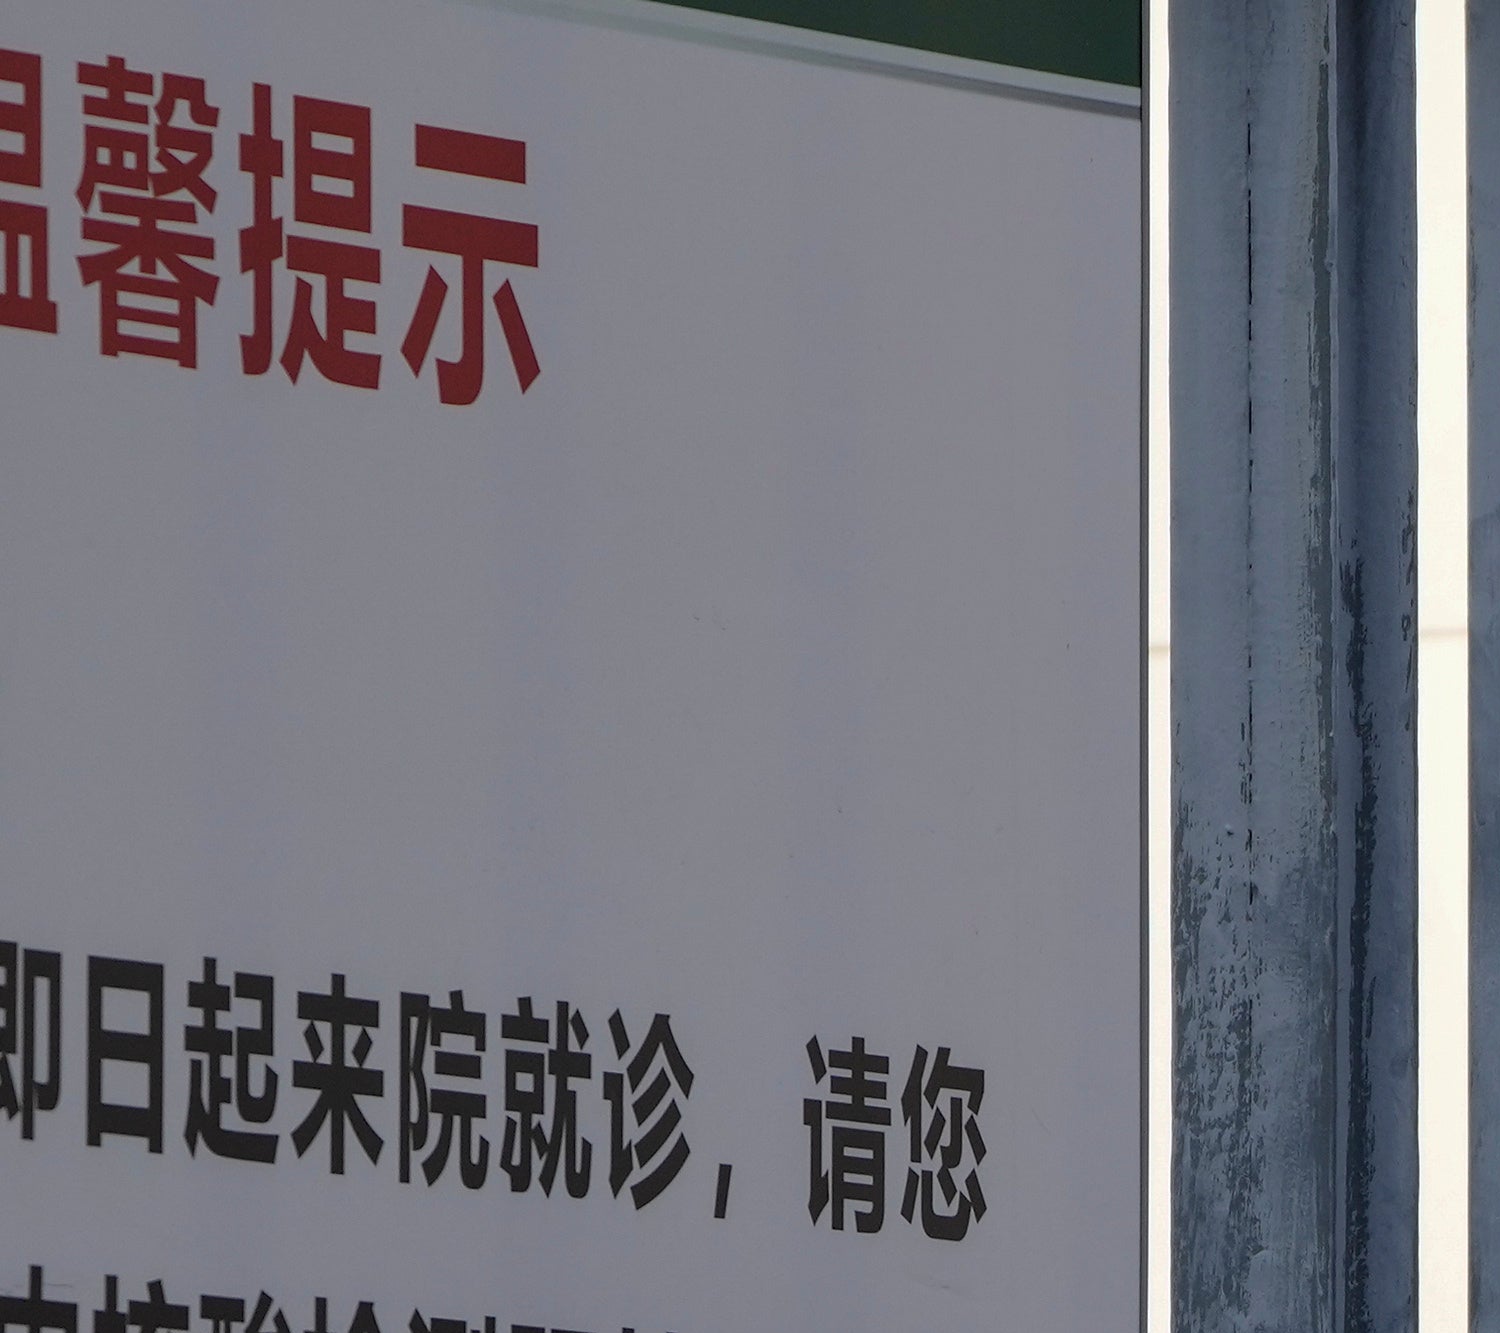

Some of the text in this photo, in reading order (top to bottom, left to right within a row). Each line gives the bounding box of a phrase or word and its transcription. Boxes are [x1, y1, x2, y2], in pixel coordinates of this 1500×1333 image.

[0, 939, 987, 1242] 即日起来院就诊，请您
